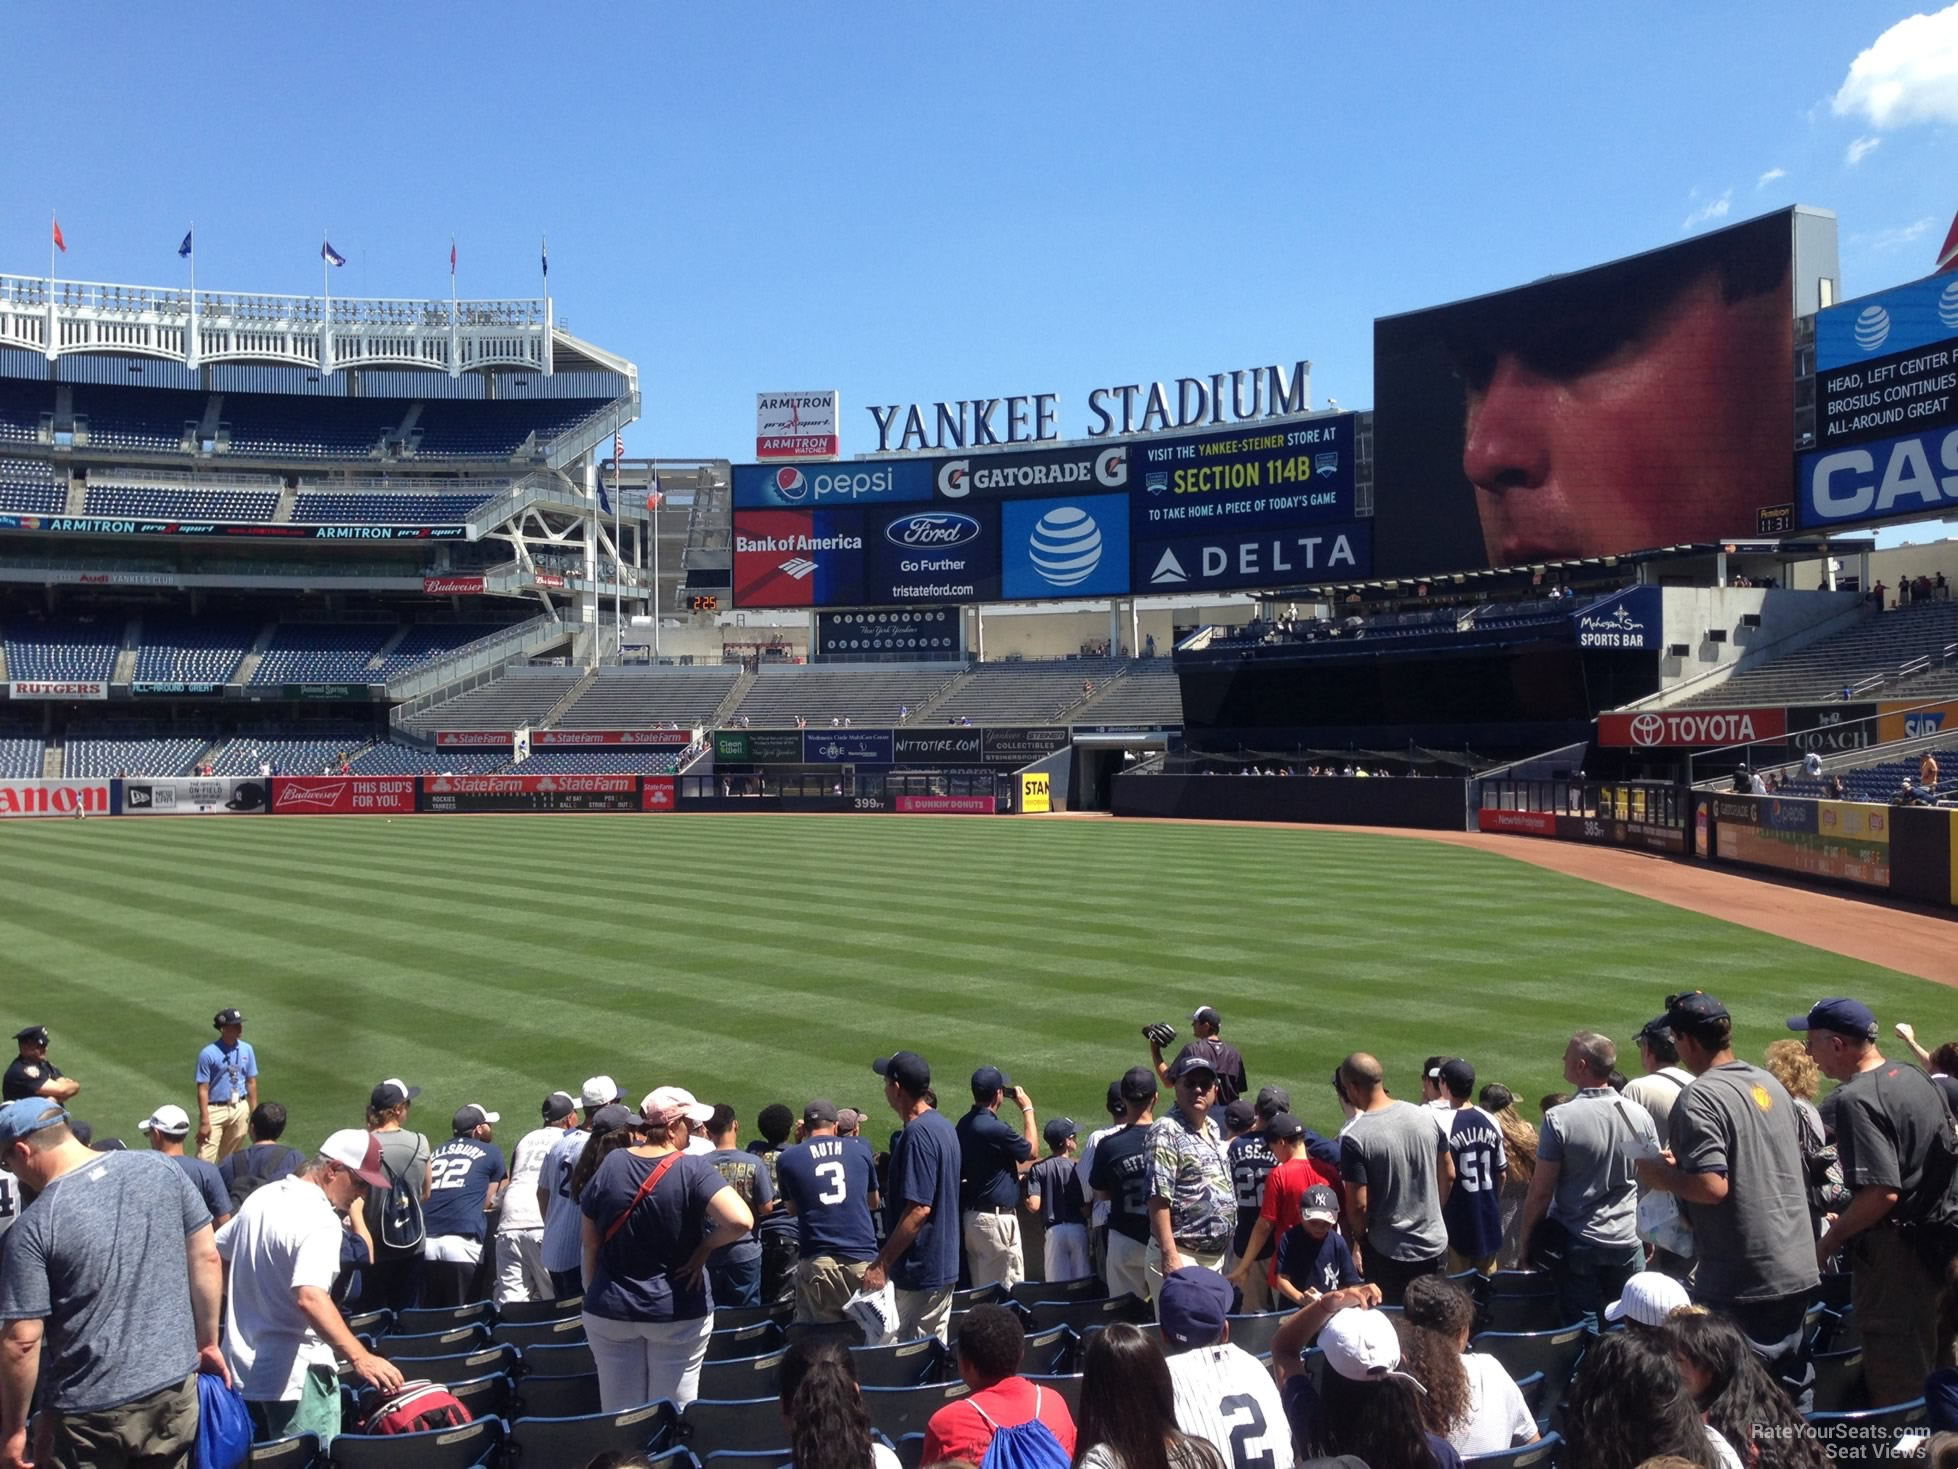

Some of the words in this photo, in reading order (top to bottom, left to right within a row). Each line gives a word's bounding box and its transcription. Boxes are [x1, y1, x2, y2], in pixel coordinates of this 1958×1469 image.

[1827, 374, 1864, 393] HEAD,
[1867, 364, 1897, 384] LEFT
[1899, 352, 1949, 376] CENTER
[1827, 391, 1881, 415] BROSIUS
[1884, 373, 1957, 402] CONTINUES
[760, 397, 832, 410] ARMITRON
[866, 393, 1060, 451] YANKEE
[1087, 360, 1312, 439] STADIUM
[1827, 407, 1904, 436] ALL-AROUND
[1907, 396, 1949, 418] GREAT
[763, 437, 828, 449] ARMITRON
[1148, 447, 1172, 461] VISIT
[1176, 445, 1196, 459] THE
[1199, 435, 1285, 456] YANKEE-STEINER
[1287, 430, 1320, 446] STORE
[1323, 427, 1336, 441] AT
[814, 467, 893, 500] pepsi
[974, 462, 1091, 490] GATORADE
[1174, 462, 1260, 494] SECTION
[1266, 456, 1310, 485] 114B
[1149, 509, 1161, 521] TO
[1163, 507, 1186, 520] TAKE
[1188, 504, 1214, 517] HOME
[1216, 504, 1223, 515] A
[1225, 502, 1252, 515] PIECE
[1254, 500, 1266, 511] OF
[1268, 495, 1308, 510] TODAY'S
[1310, 492, 1336, 506] GAME
[51, 519, 135, 532] ARMITRON
[316, 527, 392, 539] ARMITRON
[904, 517, 960, 543] Ford
[1762, 517, 1789, 532] 11:31
[736, 537, 778, 553] Bank
[779, 535, 794, 550] of
[796, 534, 862, 551] America
[1202, 535, 1356, 577] DELTA
[901, 560, 919, 572] Go
[921, 559, 966, 572] Further
[80, 574, 109, 584] Audi
[112, 576, 151, 584] YANKEES
[152, 575, 175, 584] CLUB
[425, 579, 483, 592] Budweiser
[892, 584, 974, 597] tristateford.com
[1581, 633, 1620, 646] SPORTS
[1623, 634, 1643, 647] BAR
[16, 683, 101, 694] RUTGERS
[1027, 732, 1066, 740] STEINER
[1667, 715, 1756, 742] TOYOTA
[896, 739, 980, 752] NITTOTIRE.COM
[1795, 731, 1868, 751] COACH
[284, 788, 338, 800] Budweiser
[352, 782, 378, 793] THIS
[380, 782, 412, 793] BUD'S
[352, 796, 373, 807] FOR
[376, 795, 401, 807] YOU.
[951, 801, 984, 809] DONUTS
[1720, 803, 1749, 818] GATORADE
[1783, 806, 1806, 823] pepsi
[1450, 1127, 1497, 1151] WILLIAMS
[809, 1141, 842, 1159] RUTH
[431, 1158, 472, 1190] 22
[1460, 1150, 1493, 1192] 51
[815, 1161, 846, 1205] 3
[1219, 1393, 1276, 1469] 2
